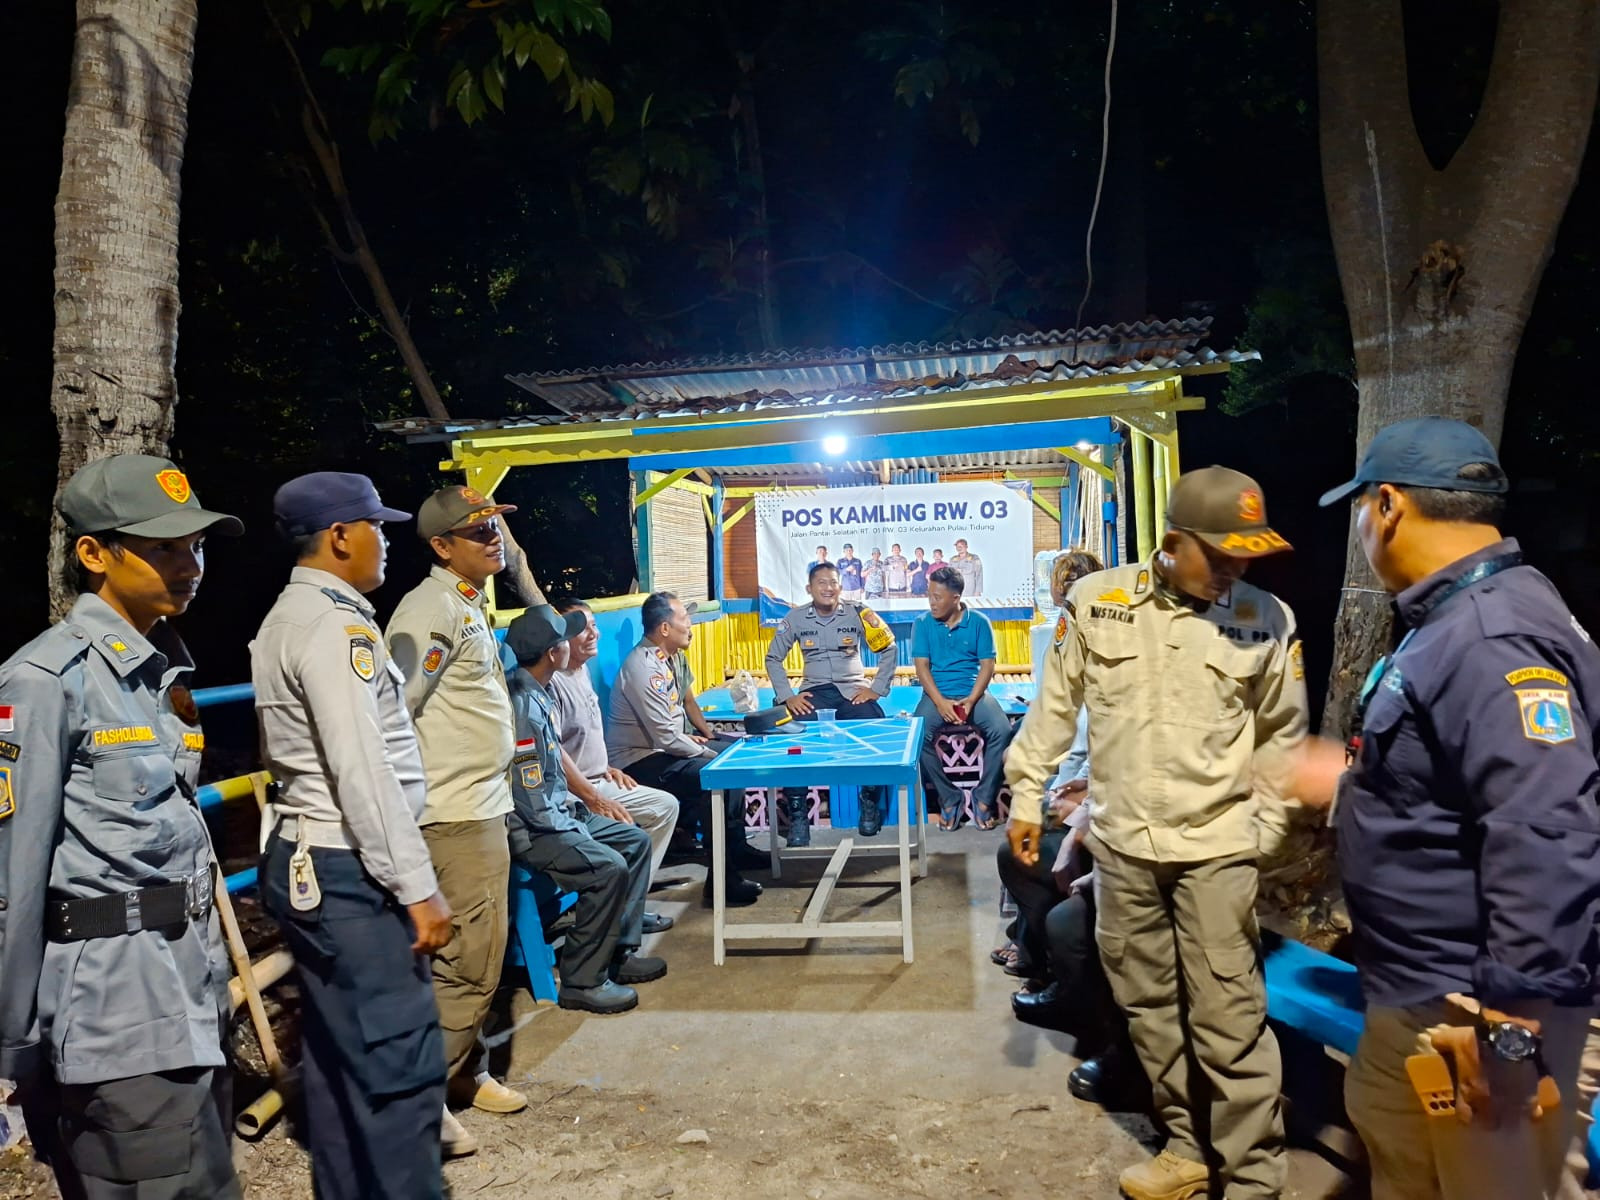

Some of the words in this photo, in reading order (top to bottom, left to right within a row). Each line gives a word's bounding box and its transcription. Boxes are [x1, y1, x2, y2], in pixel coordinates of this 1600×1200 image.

[782, 508, 823, 527] POS
[830, 503, 926, 525] KAMLING
[934, 501, 973, 520] RW.
[980, 500, 1008, 519] 03
[791, 530, 808, 538] Jalan
[810, 529, 830, 537] Pantai
[832, 528, 858, 536] Selatan
[909, 524, 945, 533] Kelurahan
[947, 523, 967, 531] Pulau
[970, 522, 995, 531] Tidung
[1218, 625, 1244, 640] POL
